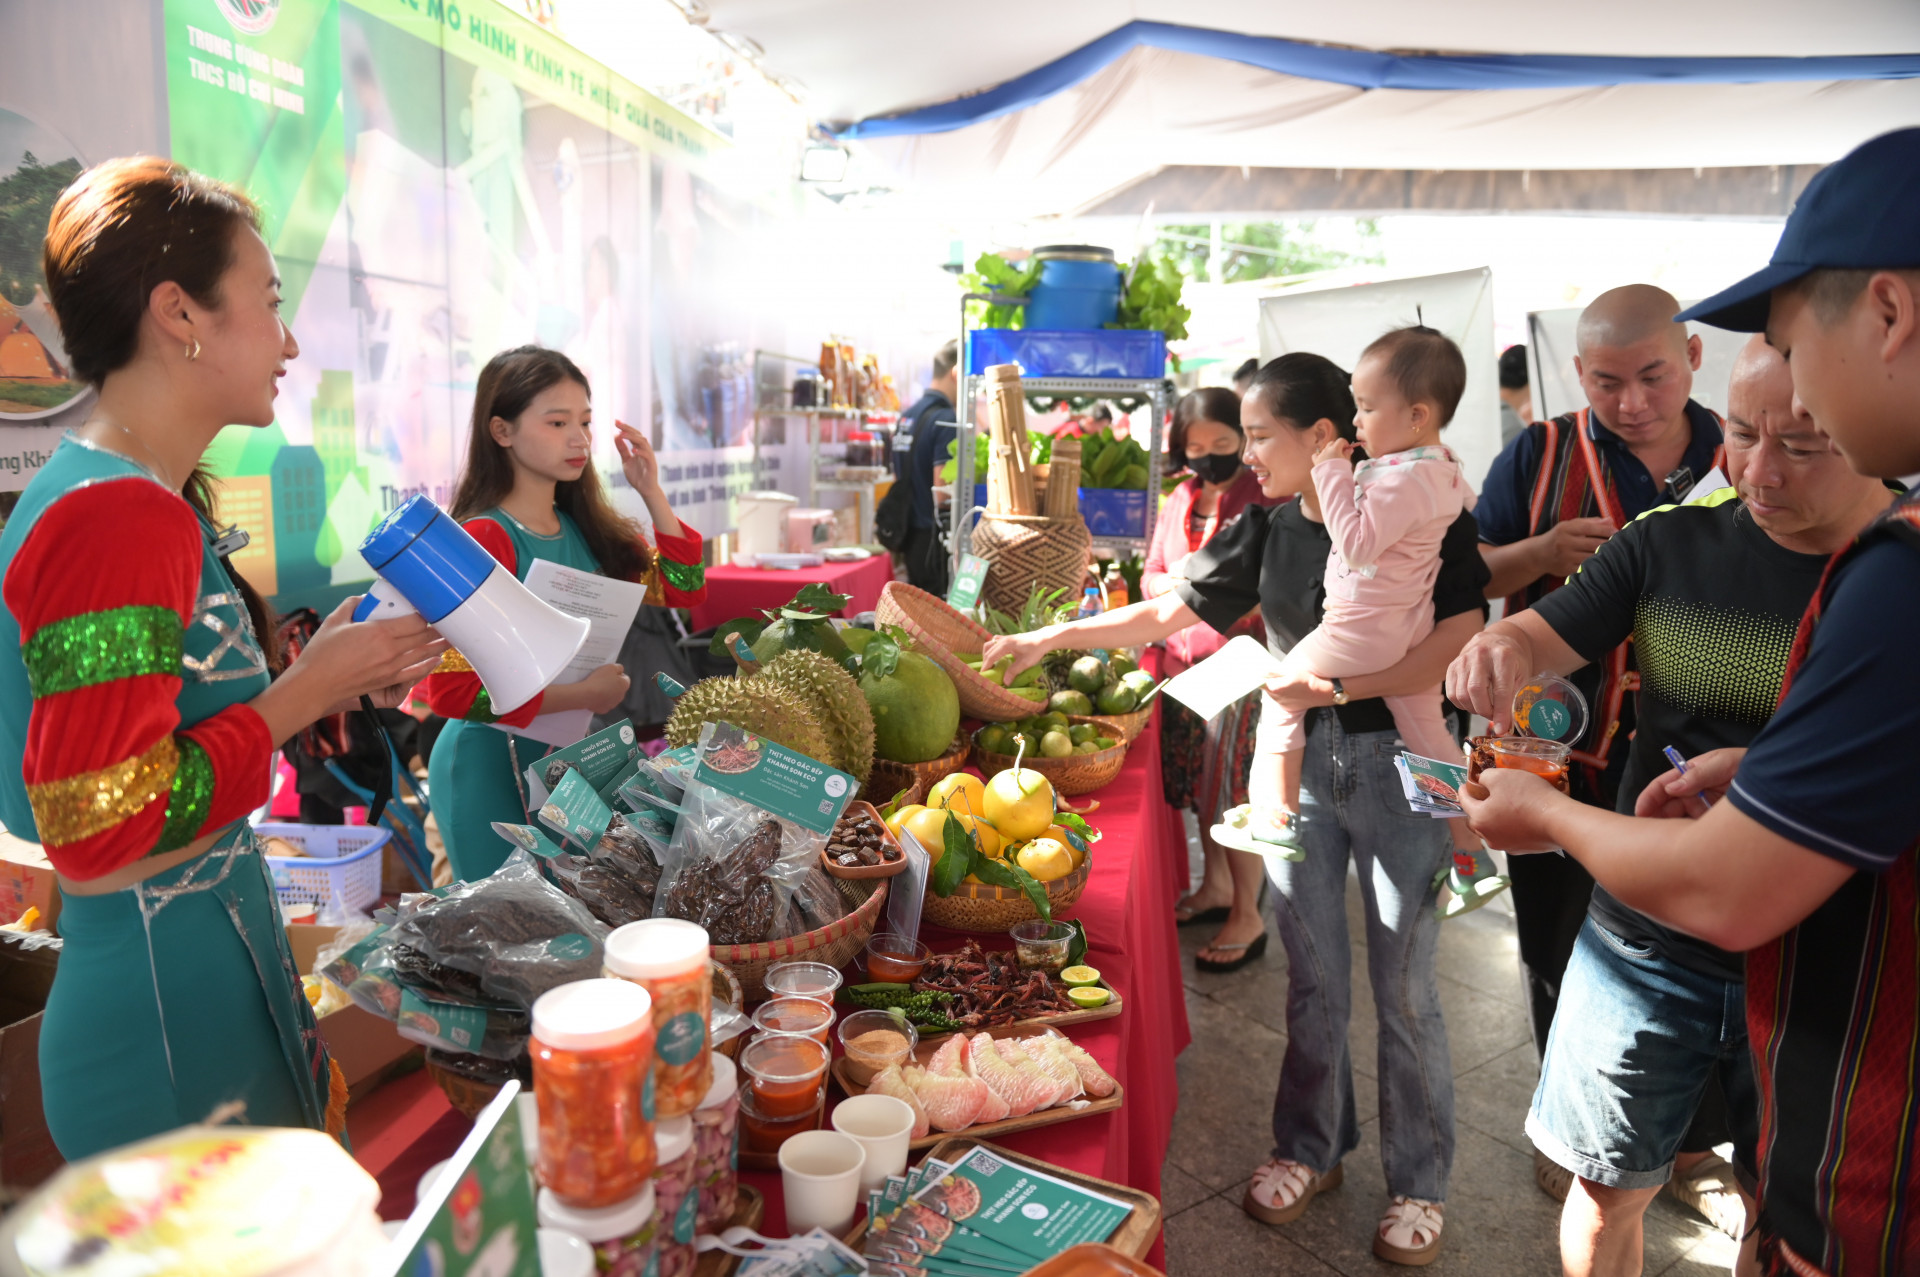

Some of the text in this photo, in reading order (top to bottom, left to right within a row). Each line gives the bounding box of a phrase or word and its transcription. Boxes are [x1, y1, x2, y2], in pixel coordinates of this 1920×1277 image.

[188, 56, 225, 88] TNCS
[523, 44, 564, 85] KINH
[0, 456, 20, 474] ng
[766, 758, 789, 770] KHANH
[803, 773, 816, 782] ECO
[768, 748, 783, 759] THỊT
[783, 754, 797, 765] HEO
[797, 759, 811, 770] GÁC
